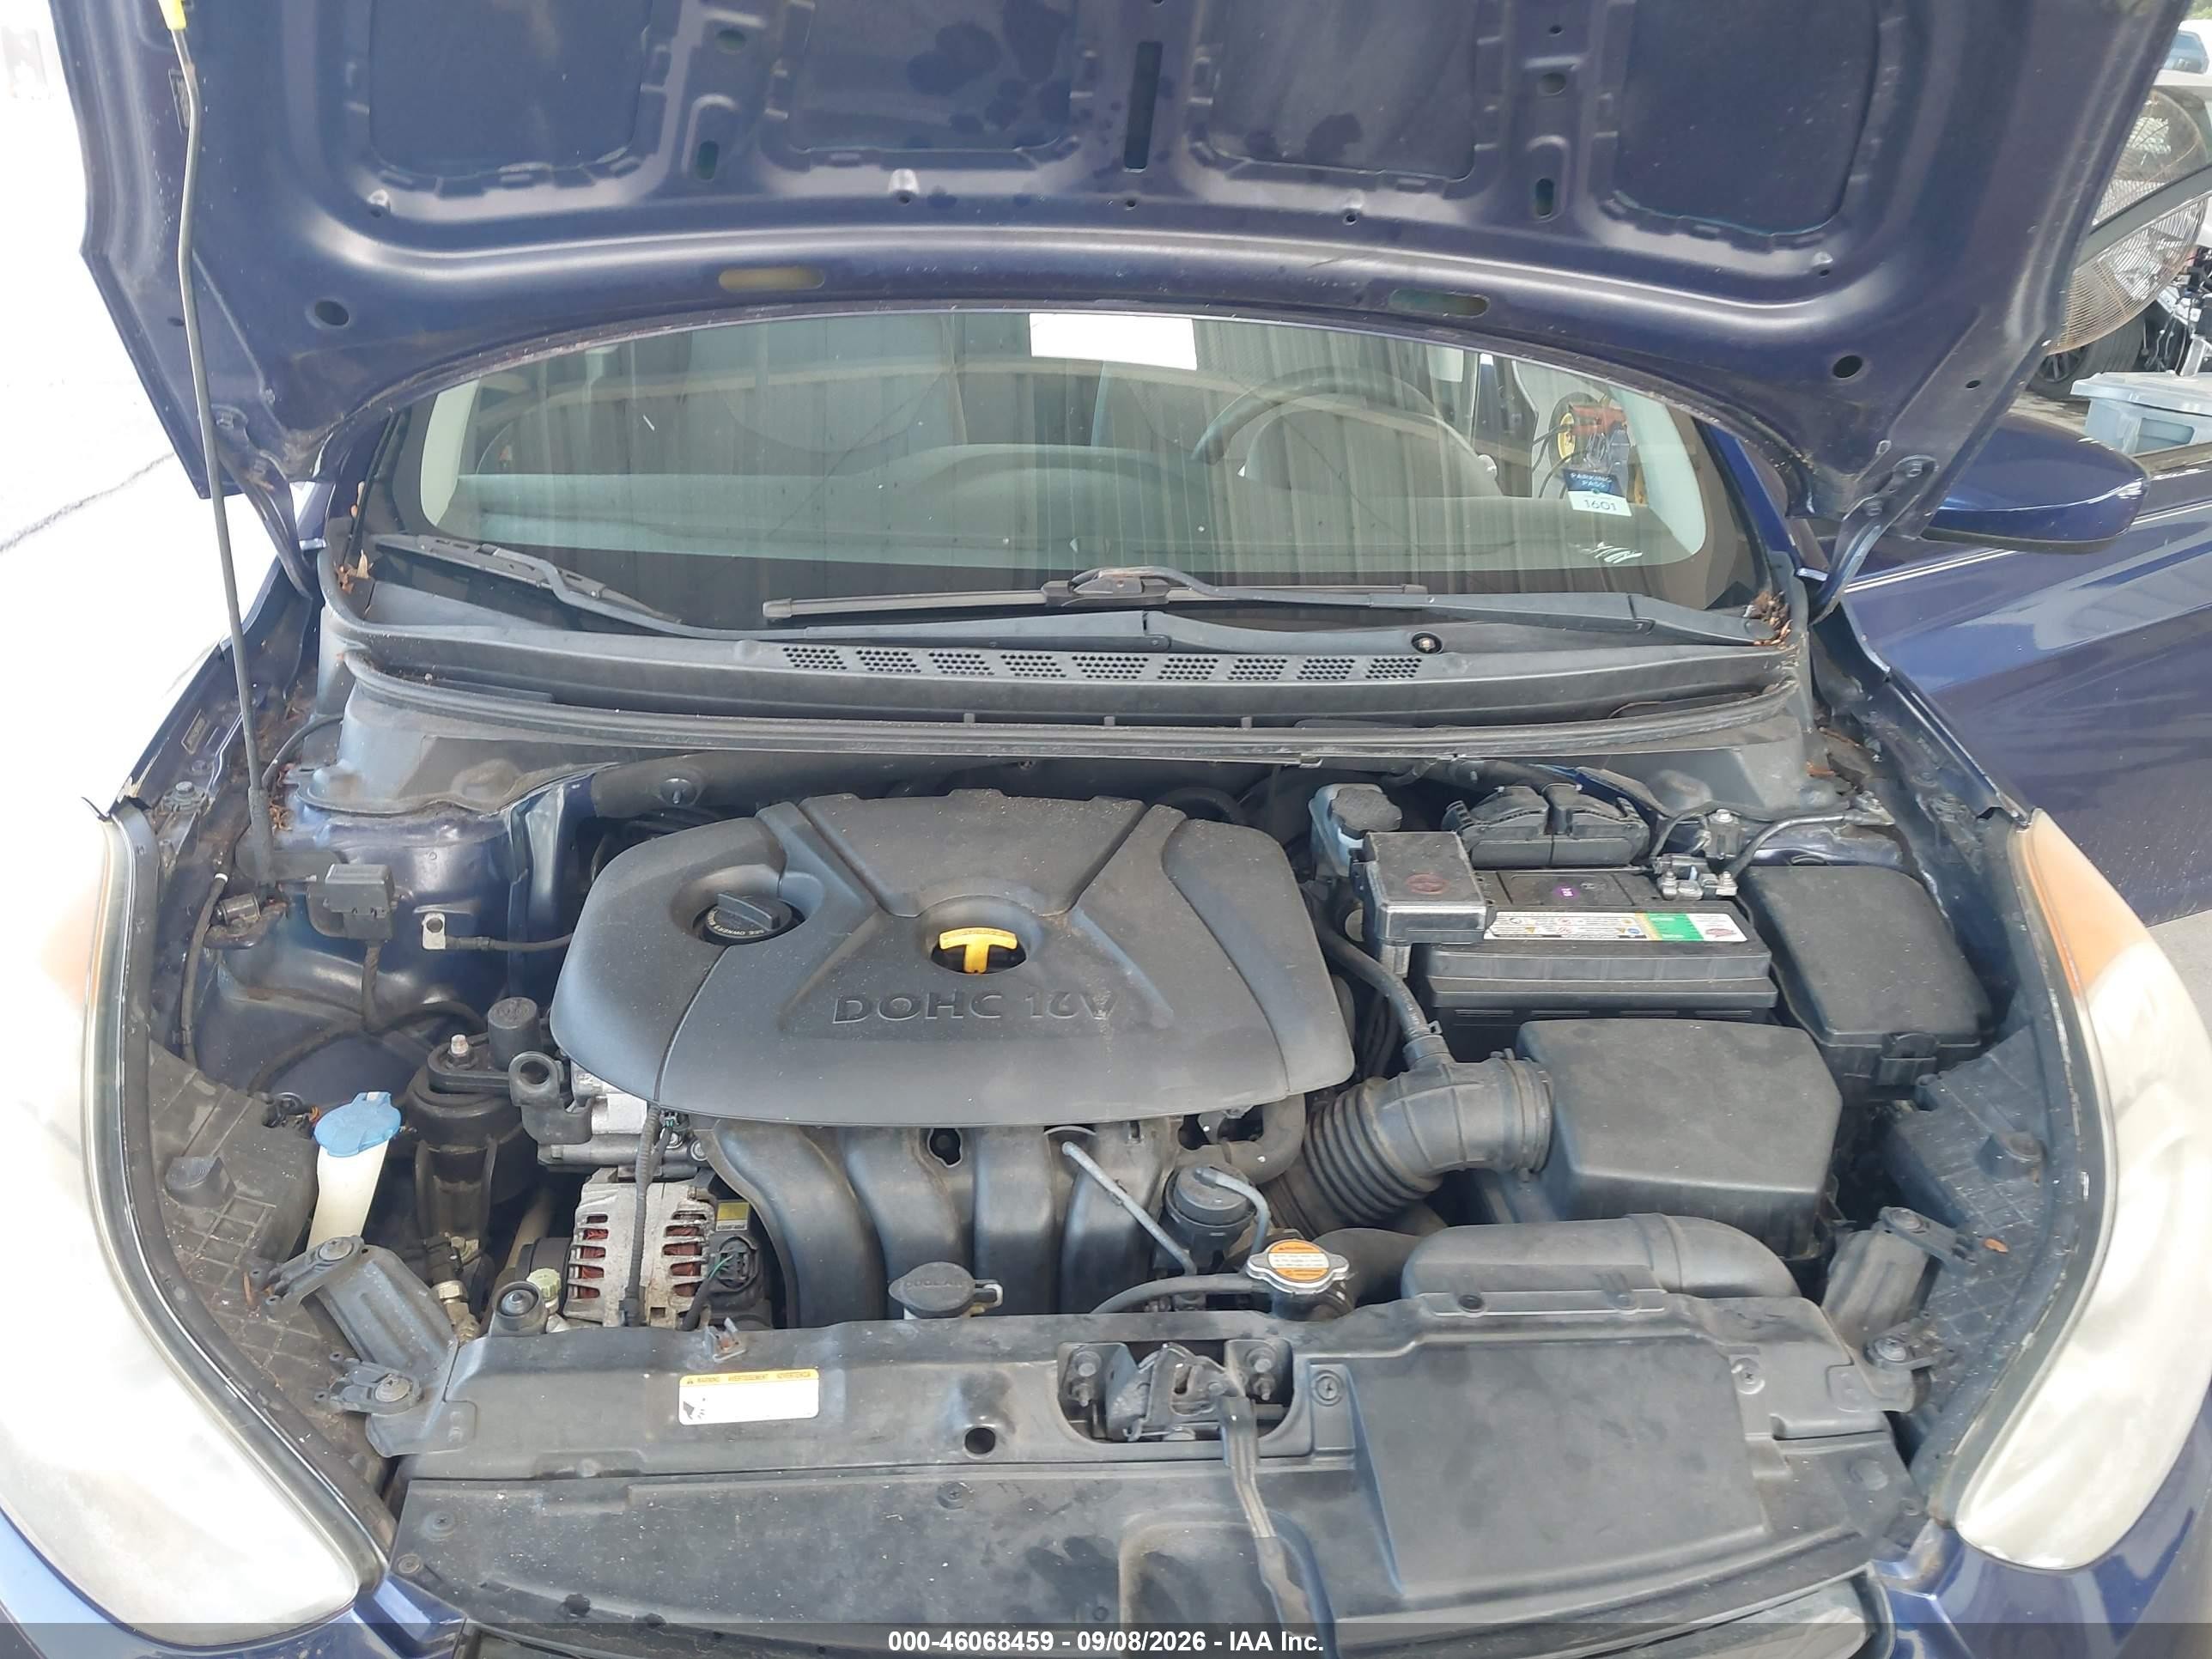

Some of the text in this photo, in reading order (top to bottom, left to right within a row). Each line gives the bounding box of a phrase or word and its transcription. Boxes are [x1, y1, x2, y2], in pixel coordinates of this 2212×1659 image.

[1583, 499, 1617, 511] 1601
[831, 992, 1115, 1024] DOHC 16V
